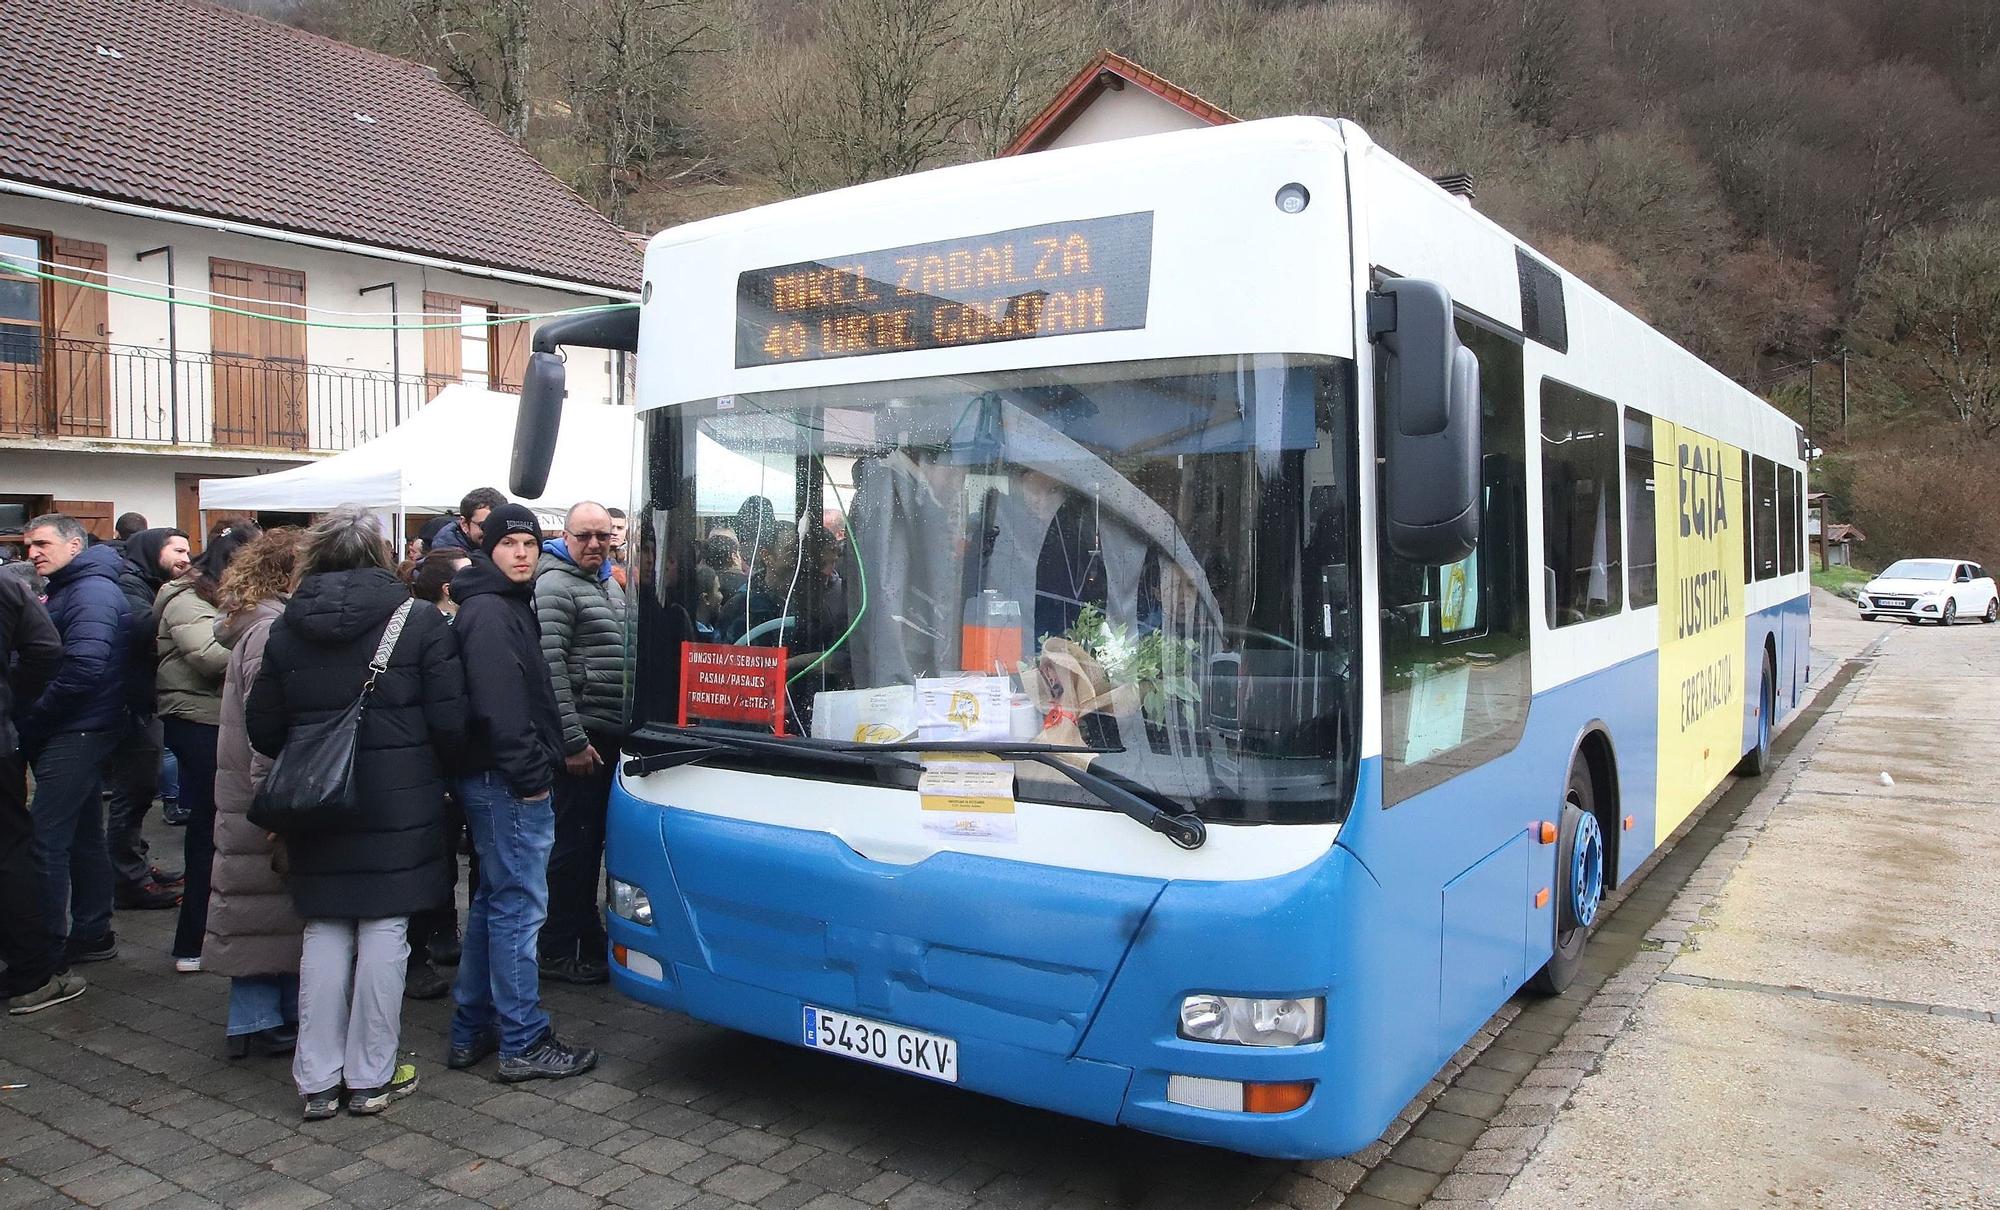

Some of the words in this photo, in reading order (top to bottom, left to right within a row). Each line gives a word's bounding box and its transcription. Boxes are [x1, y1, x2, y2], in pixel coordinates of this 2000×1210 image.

[896, 232, 1090, 296] ZABALZA
[764, 321, 806, 359] 40
[1679, 443, 1728, 541] EGIA
[1679, 569, 1730, 640] JUSTIZIA
[808, 1030, 814, 1039] E
[821, 1015, 887, 1059] 5430
[898, 1034, 948, 1074] GKV
